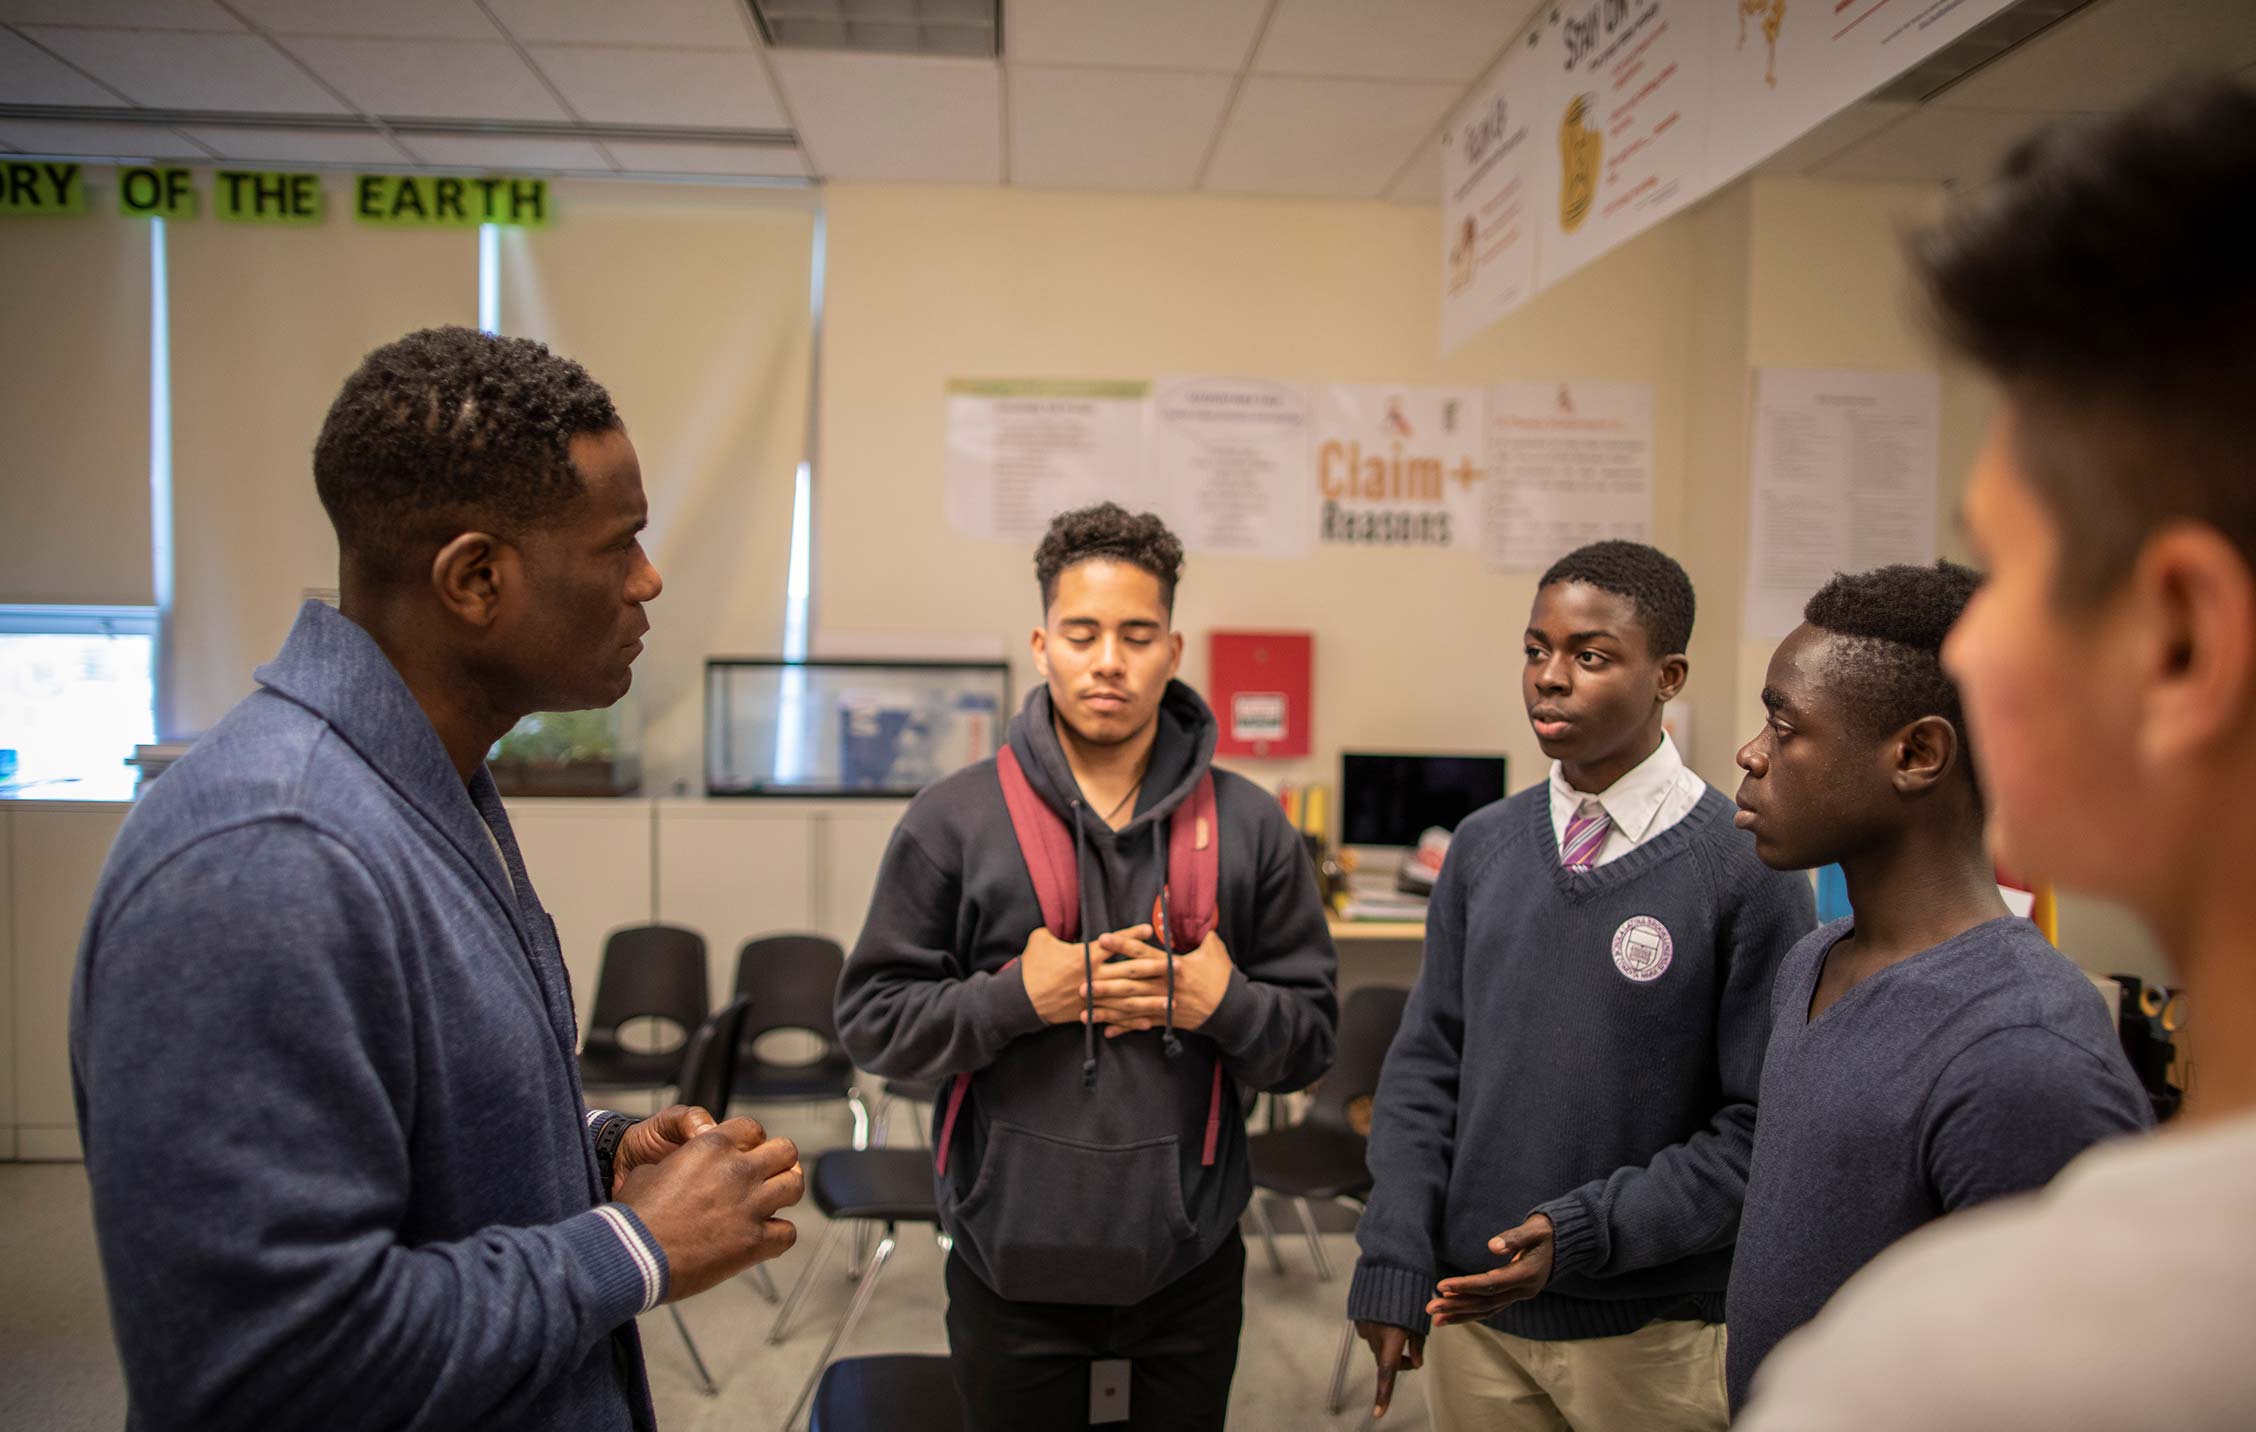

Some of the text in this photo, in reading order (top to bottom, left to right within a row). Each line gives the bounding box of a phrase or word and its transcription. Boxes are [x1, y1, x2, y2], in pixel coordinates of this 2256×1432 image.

[0, 163, 545, 220] RY OF THE EARTH
[1320, 501, 1453, 544] Reasons
